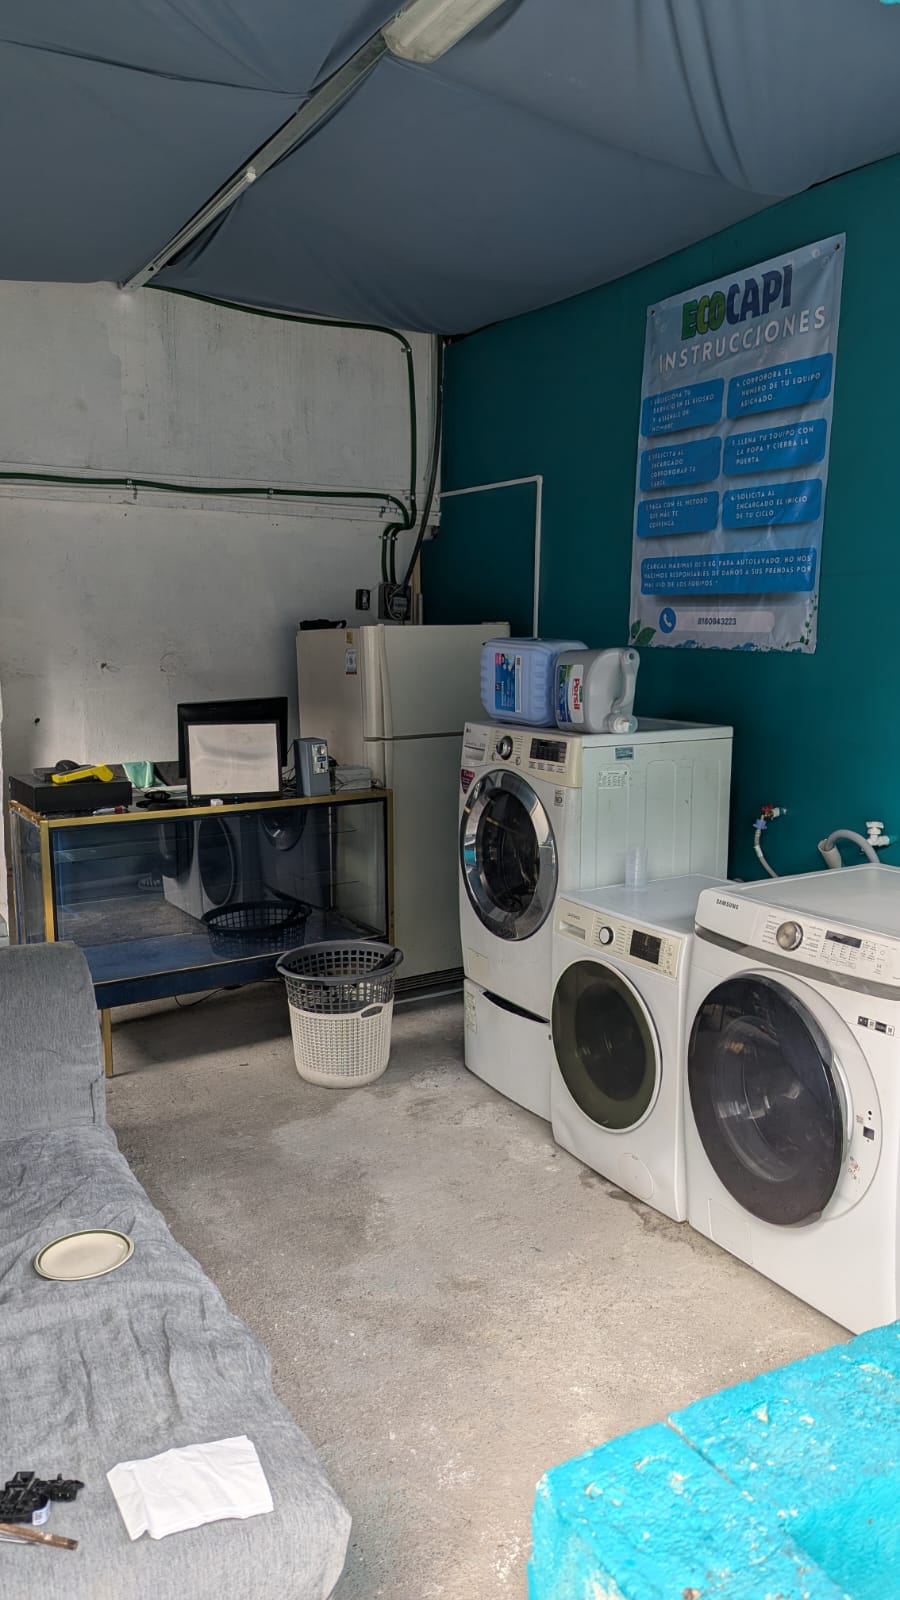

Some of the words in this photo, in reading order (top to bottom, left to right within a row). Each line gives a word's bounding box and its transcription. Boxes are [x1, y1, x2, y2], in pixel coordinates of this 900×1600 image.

[681, 264, 793, 341] ECOCAPI
[659, 306, 826, 373] INSTRUCCIONES
[785, 367, 792, 375] EL
[769, 381, 777, 390] DE
[780, 379, 790, 387] TU
[792, 372, 821, 385] EQUIPO
[760, 434, 767, 442] TU
[770, 428, 795, 440] EQUIPO
[797, 425, 815, 435] CON
[746, 445, 764, 454] ROPA
[773, 439, 798, 450] CIERRA
[800, 438, 809, 446] LA
[767, 489, 775, 497] AL
[736, 500, 774, 510] ENCARGADO
[776, 498, 783, 506] EL
[785, 495, 808, 505] INICIO
[718, 559, 734, 567] PARA
[784, 555, 795, 564] NO
[797, 554, 812, 562] NOS
[721, 567, 743, 577] DAÑOS
[751, 567, 763, 575] SUS
[765, 566, 794, 575] PRENDAS
[796, 565, 812, 573] POR
[573, 678, 581, 710] Persil
[715, 898, 739, 910] SAMSUNG
